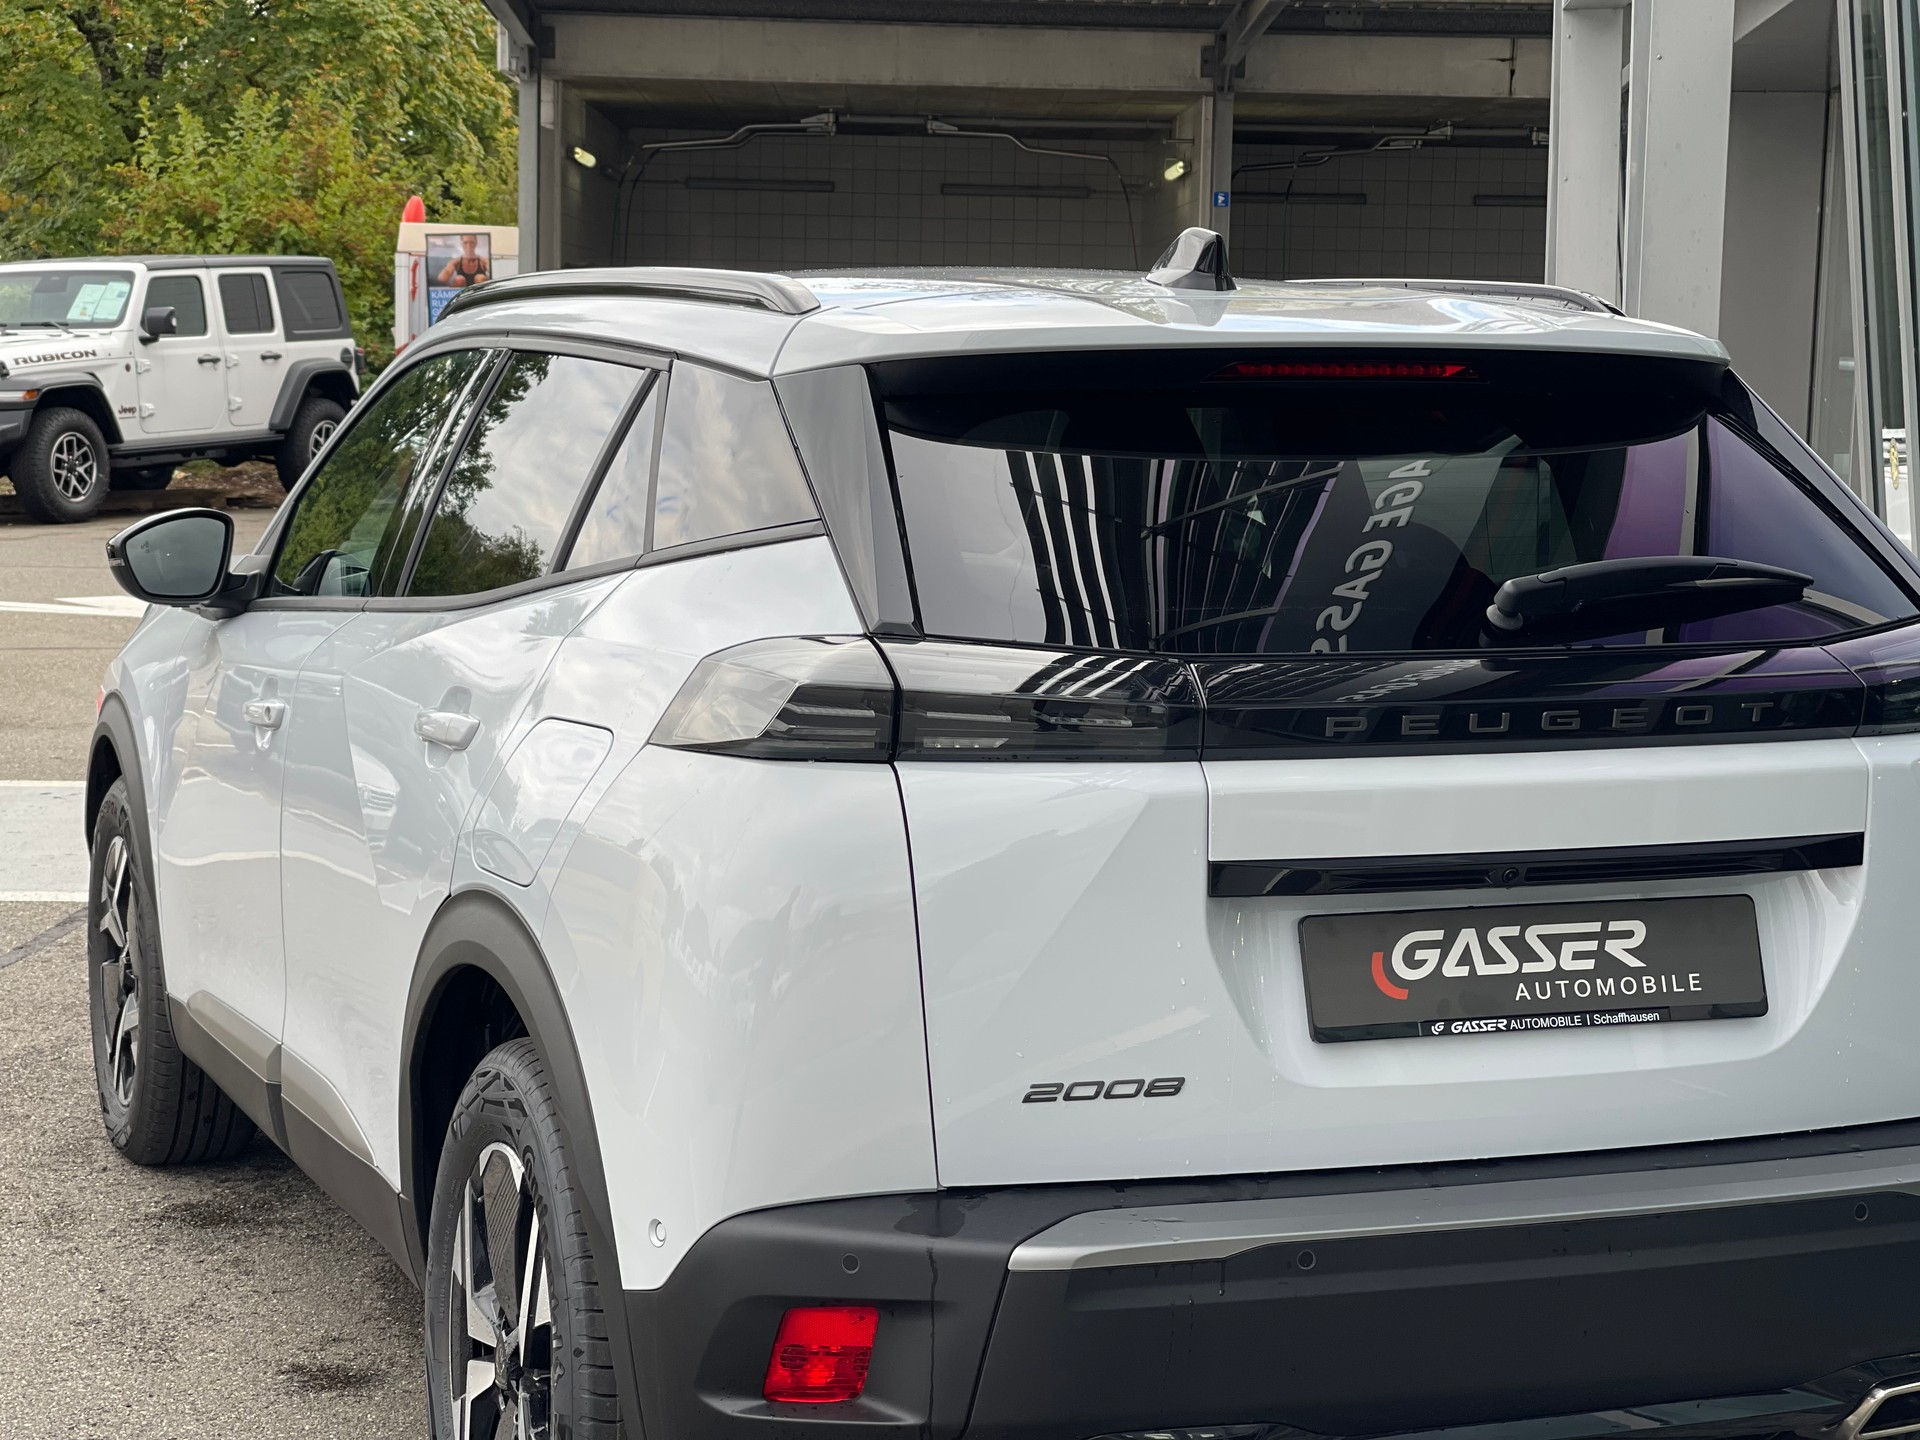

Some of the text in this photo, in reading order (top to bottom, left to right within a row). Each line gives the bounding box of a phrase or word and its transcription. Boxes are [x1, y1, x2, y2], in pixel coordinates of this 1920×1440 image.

[13, 349, 97, 365] RUBICON
[118, 404, 137, 415] Jeep
[1325, 702, 1774, 737] PEUGEOT
[1391, 919, 1648, 981] GASSER
[1515, 973, 1702, 1001] AUTOMOBILE
[1450, 1019, 1507, 1033] GASSER
[1510, 1015, 1583, 1030] AUTOMOBILE
[1593, 1011, 1660, 1025] Schaffhausen
[1022, 1077, 1185, 1103] 2008
